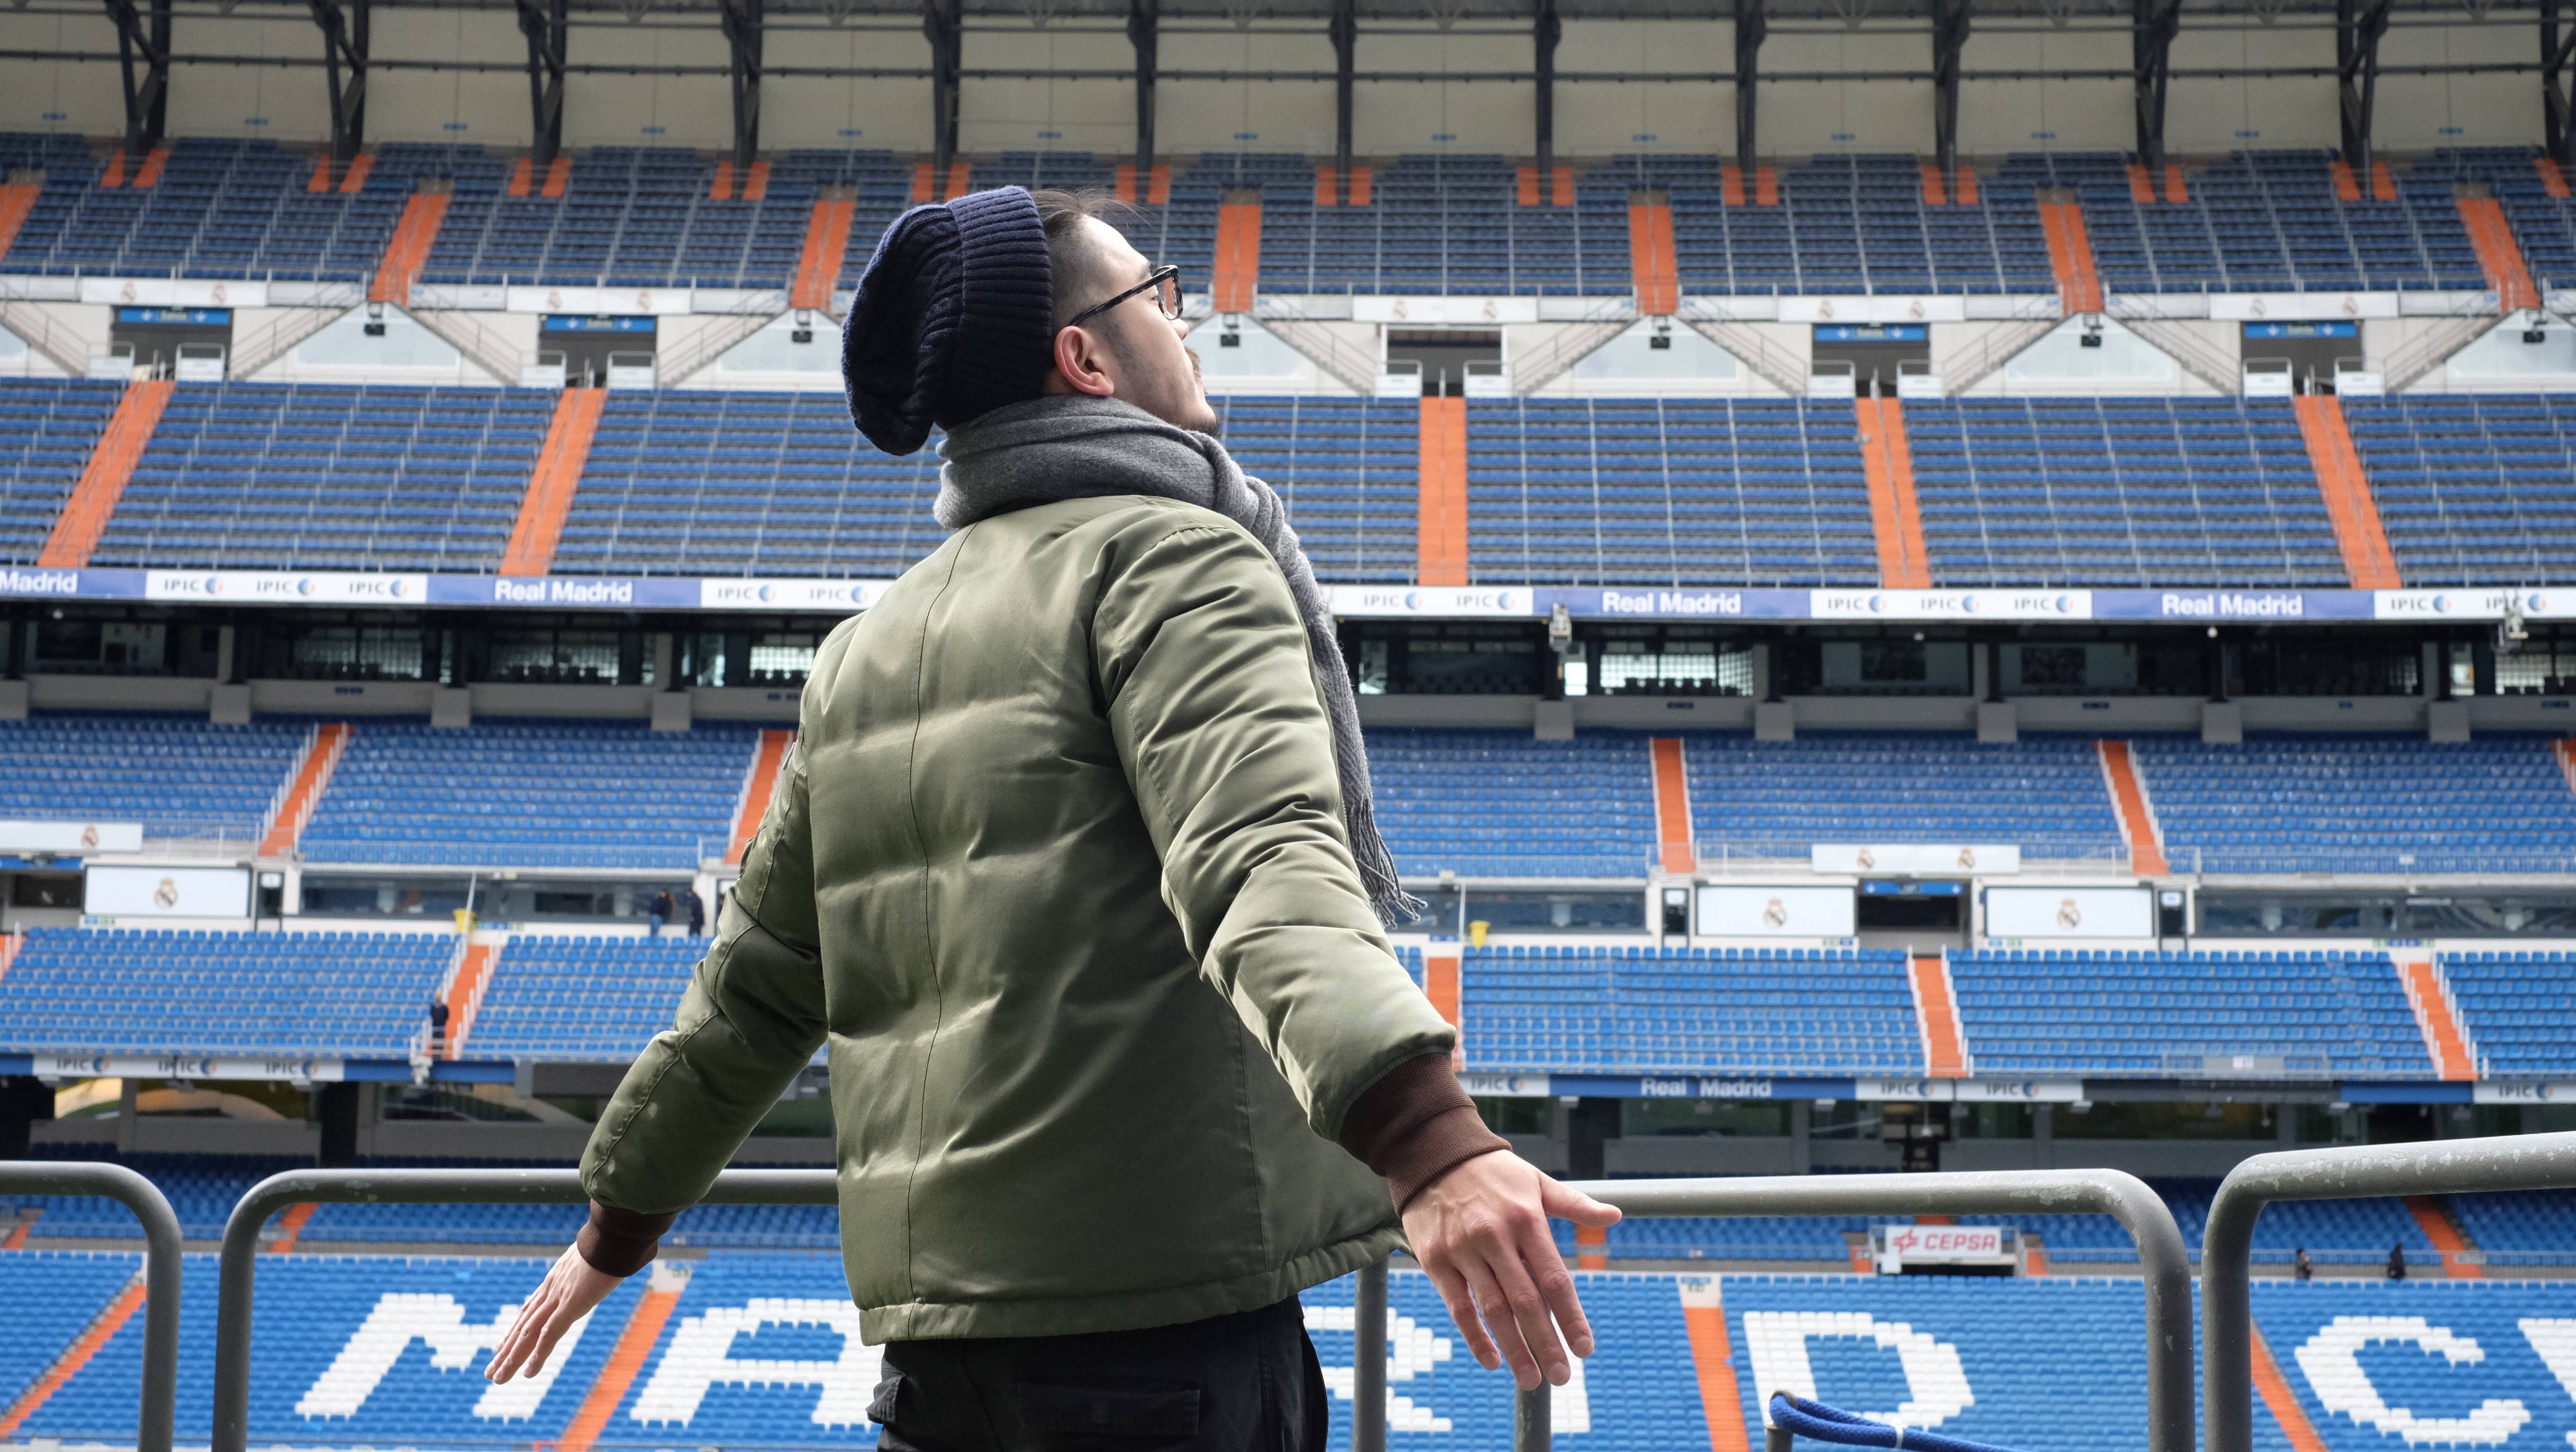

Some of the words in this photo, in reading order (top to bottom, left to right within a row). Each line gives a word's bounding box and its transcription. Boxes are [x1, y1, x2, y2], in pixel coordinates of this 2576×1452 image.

[0, 570, 78, 593] Madrid
[163, 579, 200, 593] IPIC
[256, 580, 293, 594] IPIC
[348, 581, 385, 595] IPIC
[494, 579, 548, 603] Real
[550, 580, 633, 603] Madrid
[717, 587, 753, 600] IPIC
[809, 588, 846, 601] IPIC
[1364, 594, 1400, 607] IPIC
[1456, 595, 1493, 608] IPIC
[1602, 592, 1655, 614] Real
[1658, 592, 1742, 615] Madrid
[1827, 598, 1864, 611] IPIC
[1920, 598, 1957, 611] IPIC
[2014, 598, 2051, 611] IPIC
[2161, 592, 2216, 616] Real
[2219, 592, 2303, 616] Madrid
[2391, 597, 2428, 611] IPIC
[56, 1058, 88, 1072] IPIC
[266, 1061, 298, 1074] IPIC
[1470, 1078, 1503, 1091] IPIC
[1641, 1078, 1687, 1097] Real
[1699, 1079, 1772, 1097] Madrid
[1881, 1082, 1915, 1095] IPIC
[1986, 1082, 2019, 1095] IPIC
[2500, 1084, 2533, 1098] IPIC
[1925, 1233, 1996, 1251] CEPSA
